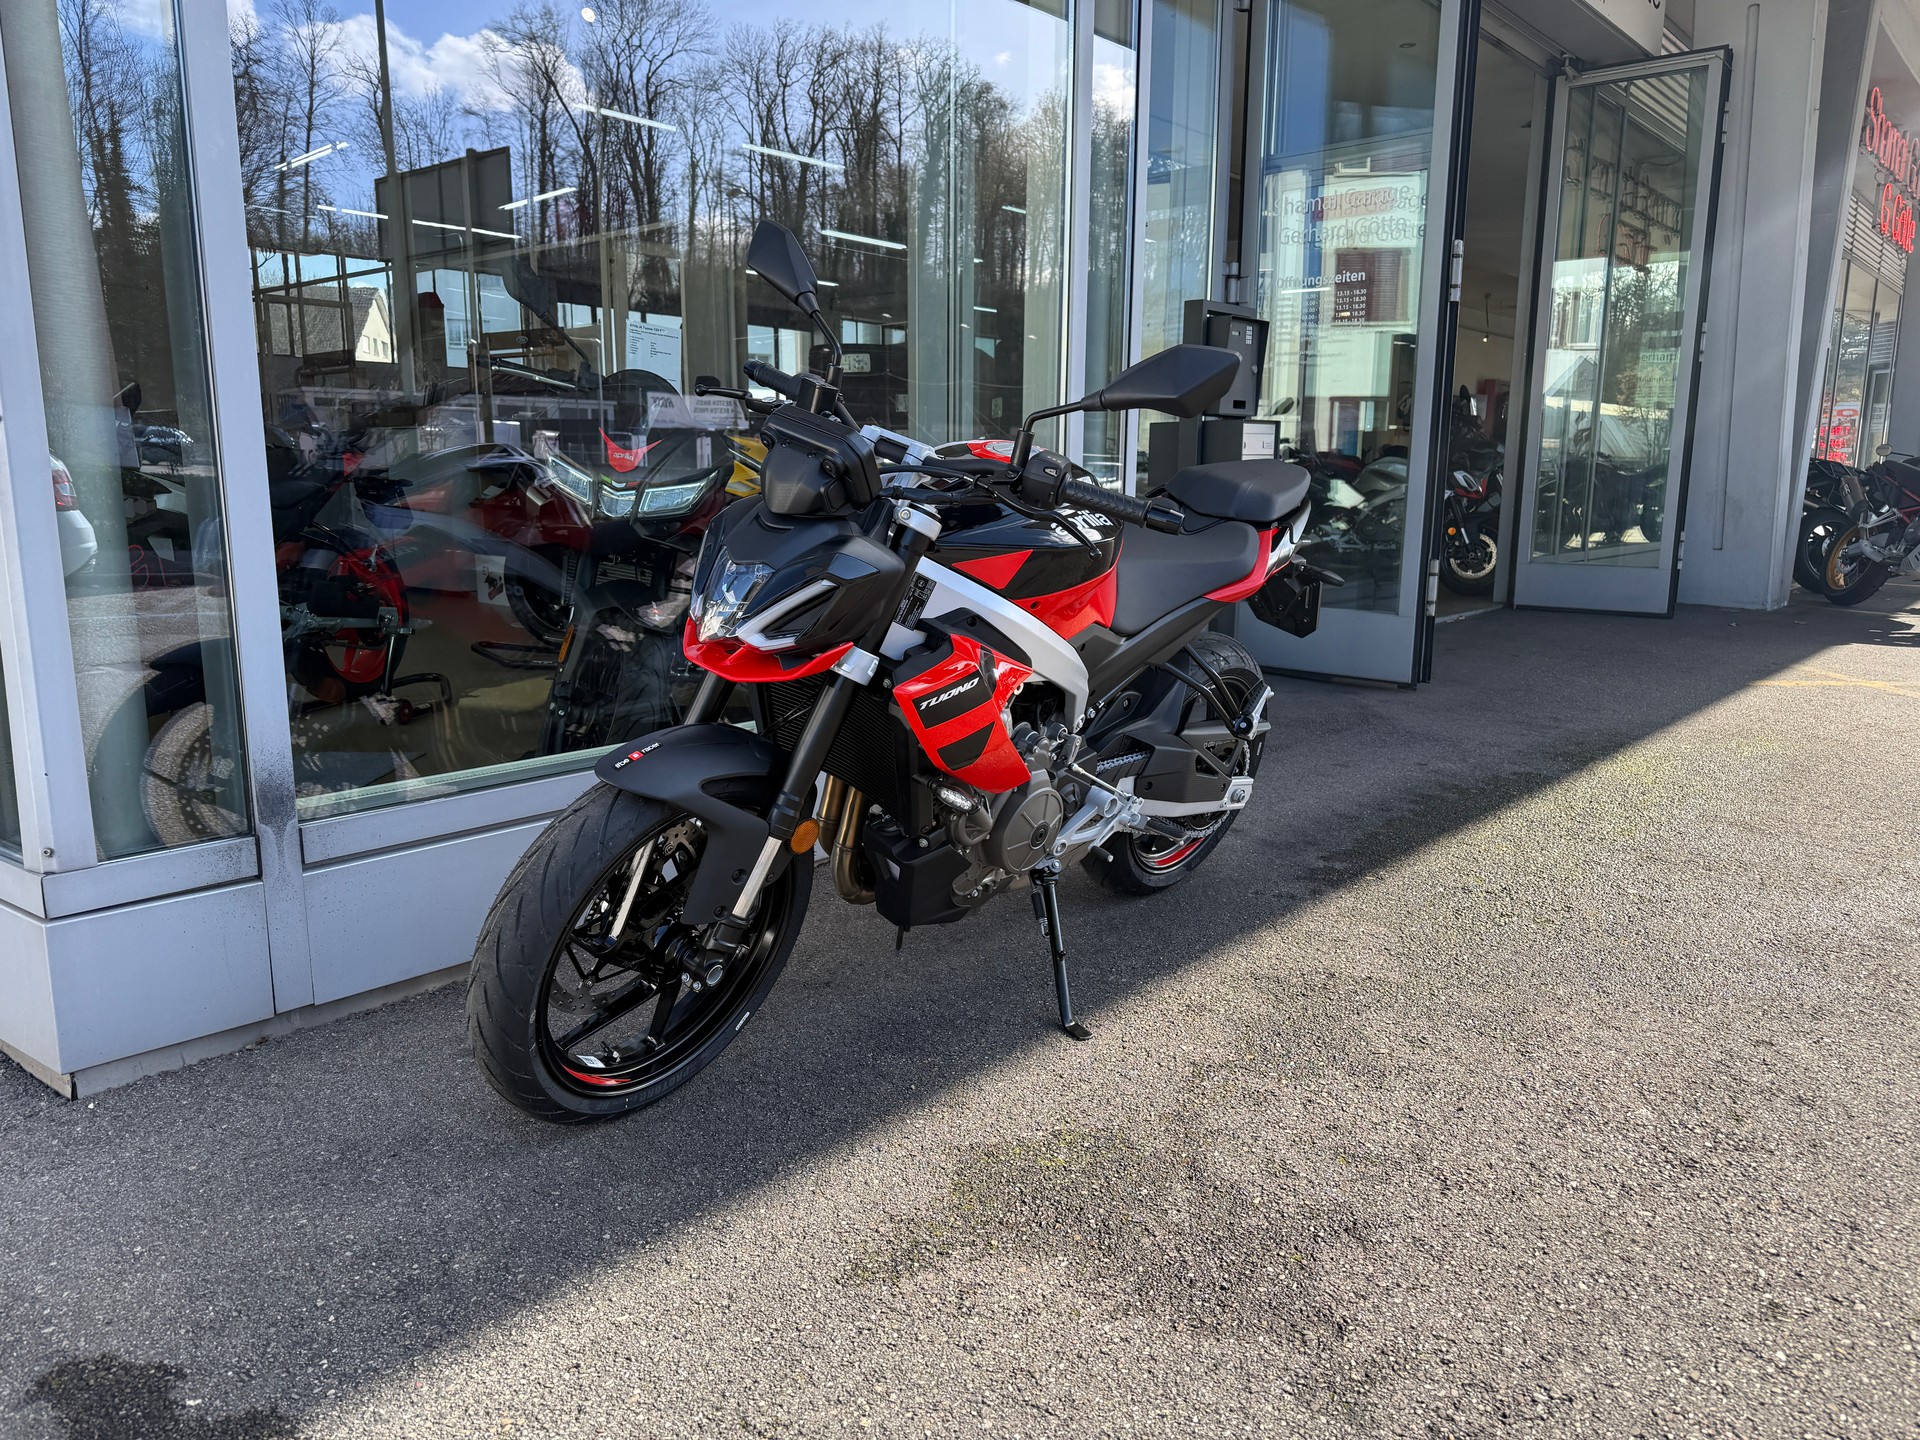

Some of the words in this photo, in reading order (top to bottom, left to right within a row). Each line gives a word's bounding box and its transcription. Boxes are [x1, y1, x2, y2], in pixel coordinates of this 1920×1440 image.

[1273, 189, 1338, 217] Shamal
[1281, 218, 1349, 245] Gerhard
[613, 451, 635, 462] aprilia
[920, 677, 980, 710] TUONO
